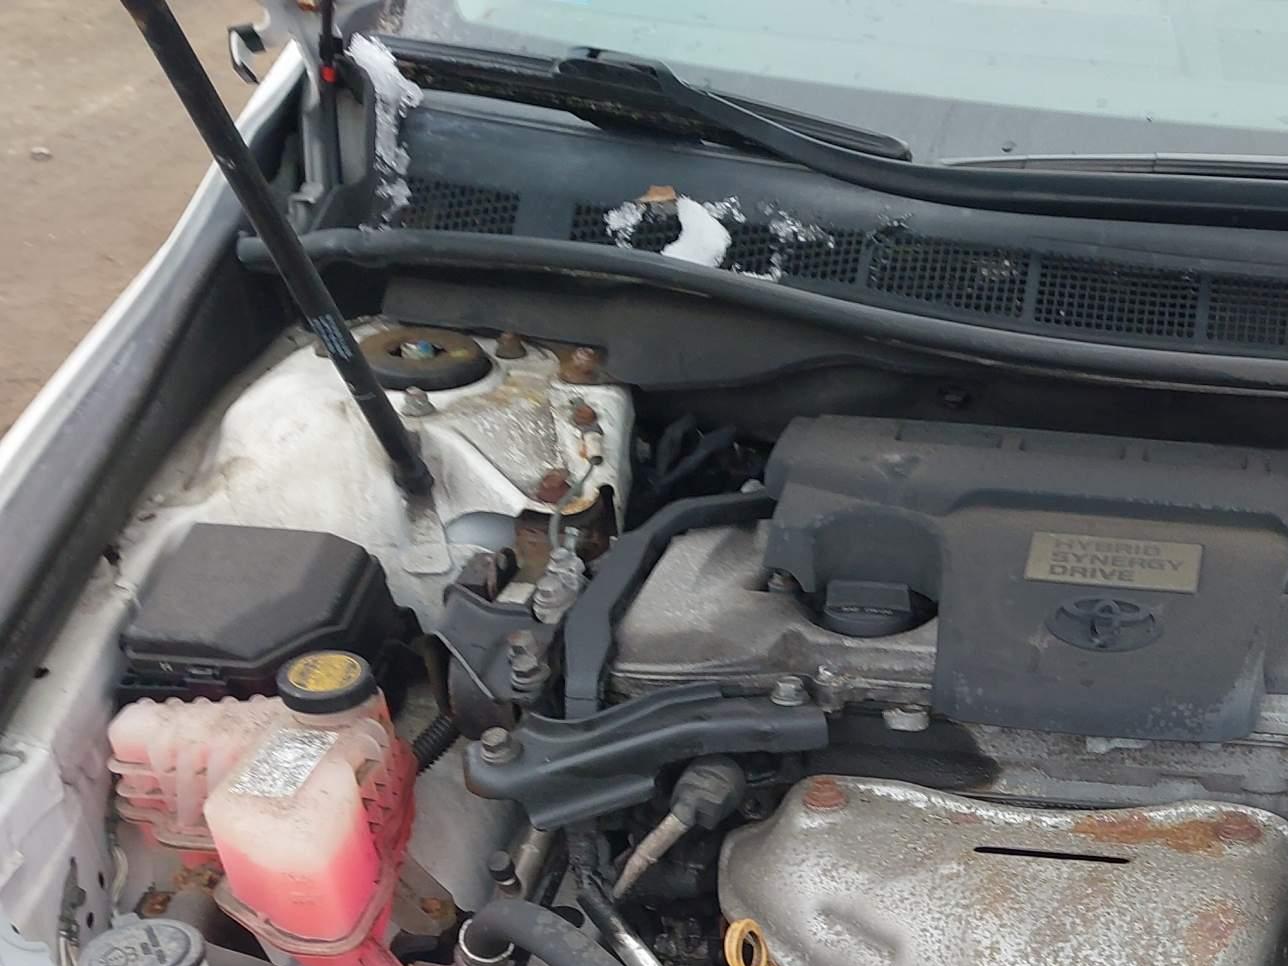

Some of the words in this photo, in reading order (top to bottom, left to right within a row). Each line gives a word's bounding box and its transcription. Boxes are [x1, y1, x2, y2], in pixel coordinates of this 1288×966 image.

[1053, 537, 1161, 558] HYBRID
[1050, 550, 1185, 572] SYNERGY
[1048, 563, 1136, 583] DRIVE
